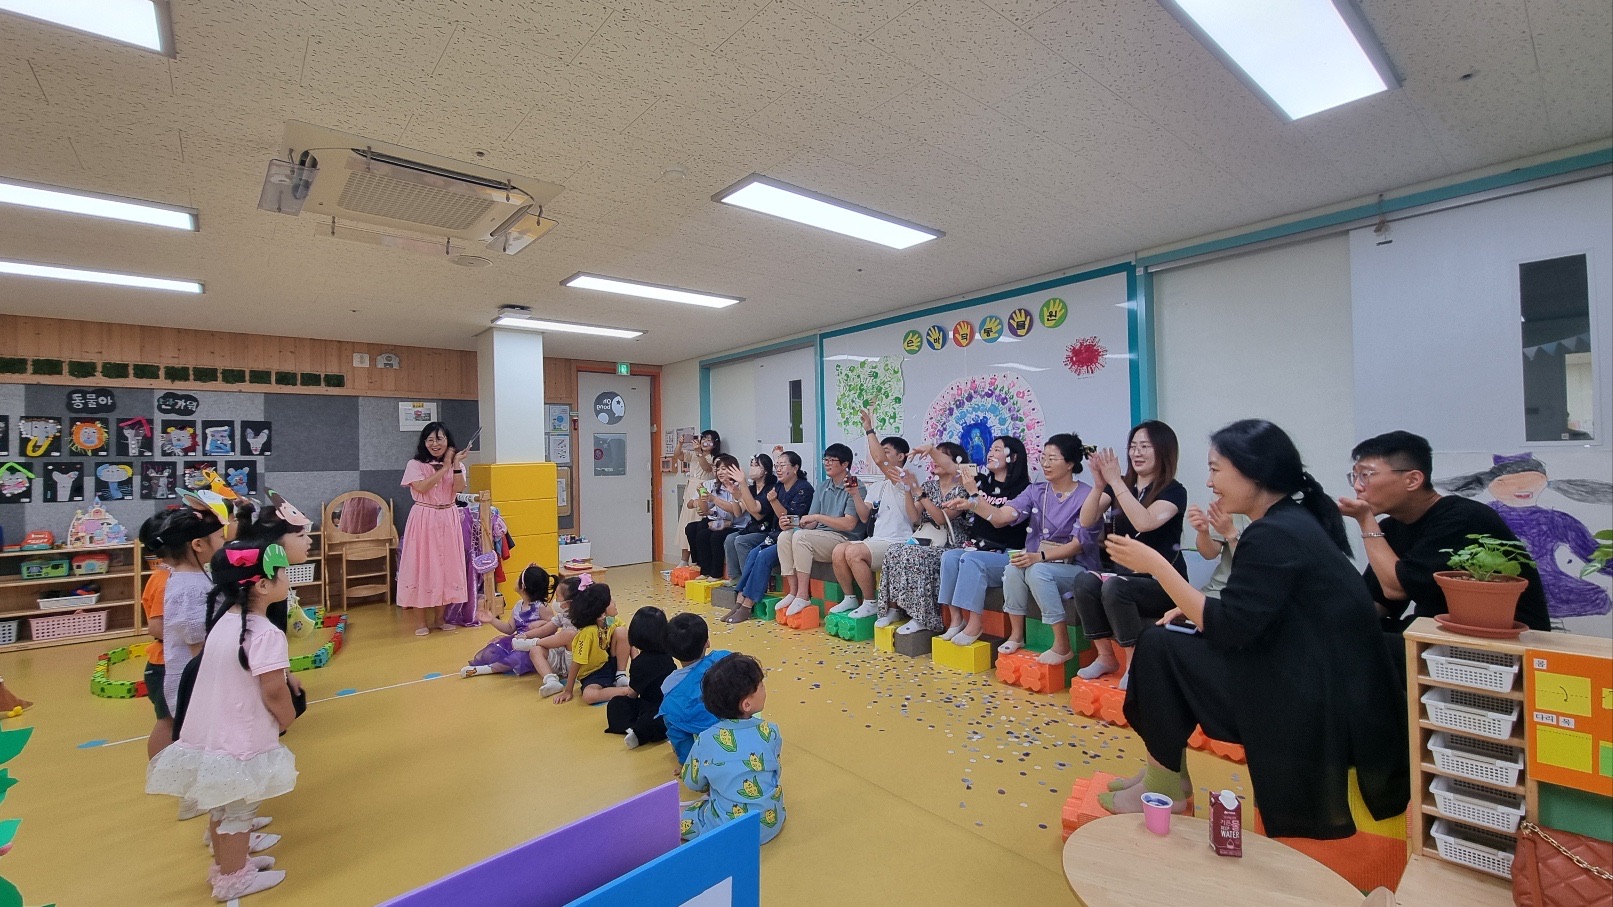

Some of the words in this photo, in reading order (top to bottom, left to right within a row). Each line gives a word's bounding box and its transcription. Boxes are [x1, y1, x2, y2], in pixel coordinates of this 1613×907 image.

[1047, 311, 1057, 321] 원
[72, 393, 113, 409] 동물아
[158, 397, 198, 412] 반가워
[1535, 714, 1553, 722] 다리
[1220, 830, 1240, 838] WATER
